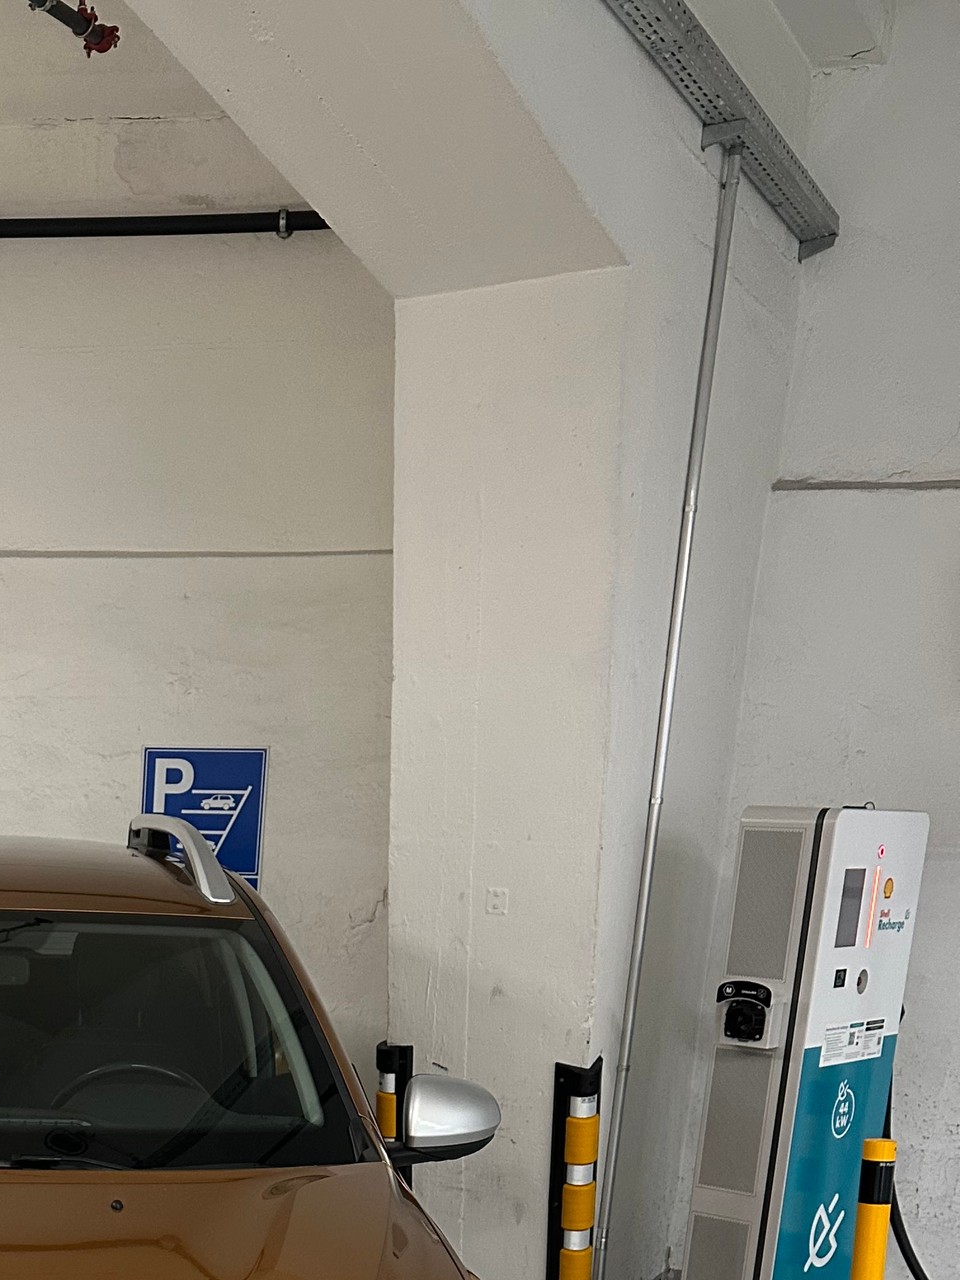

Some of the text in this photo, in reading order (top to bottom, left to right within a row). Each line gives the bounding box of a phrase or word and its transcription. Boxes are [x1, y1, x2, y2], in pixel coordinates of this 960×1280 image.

[153, 758, 194, 813] P
[877, 918, 905, 932] Recharge
[839, 1101, 849, 1114] 44
[835, 1114, 849, 1128] kW
